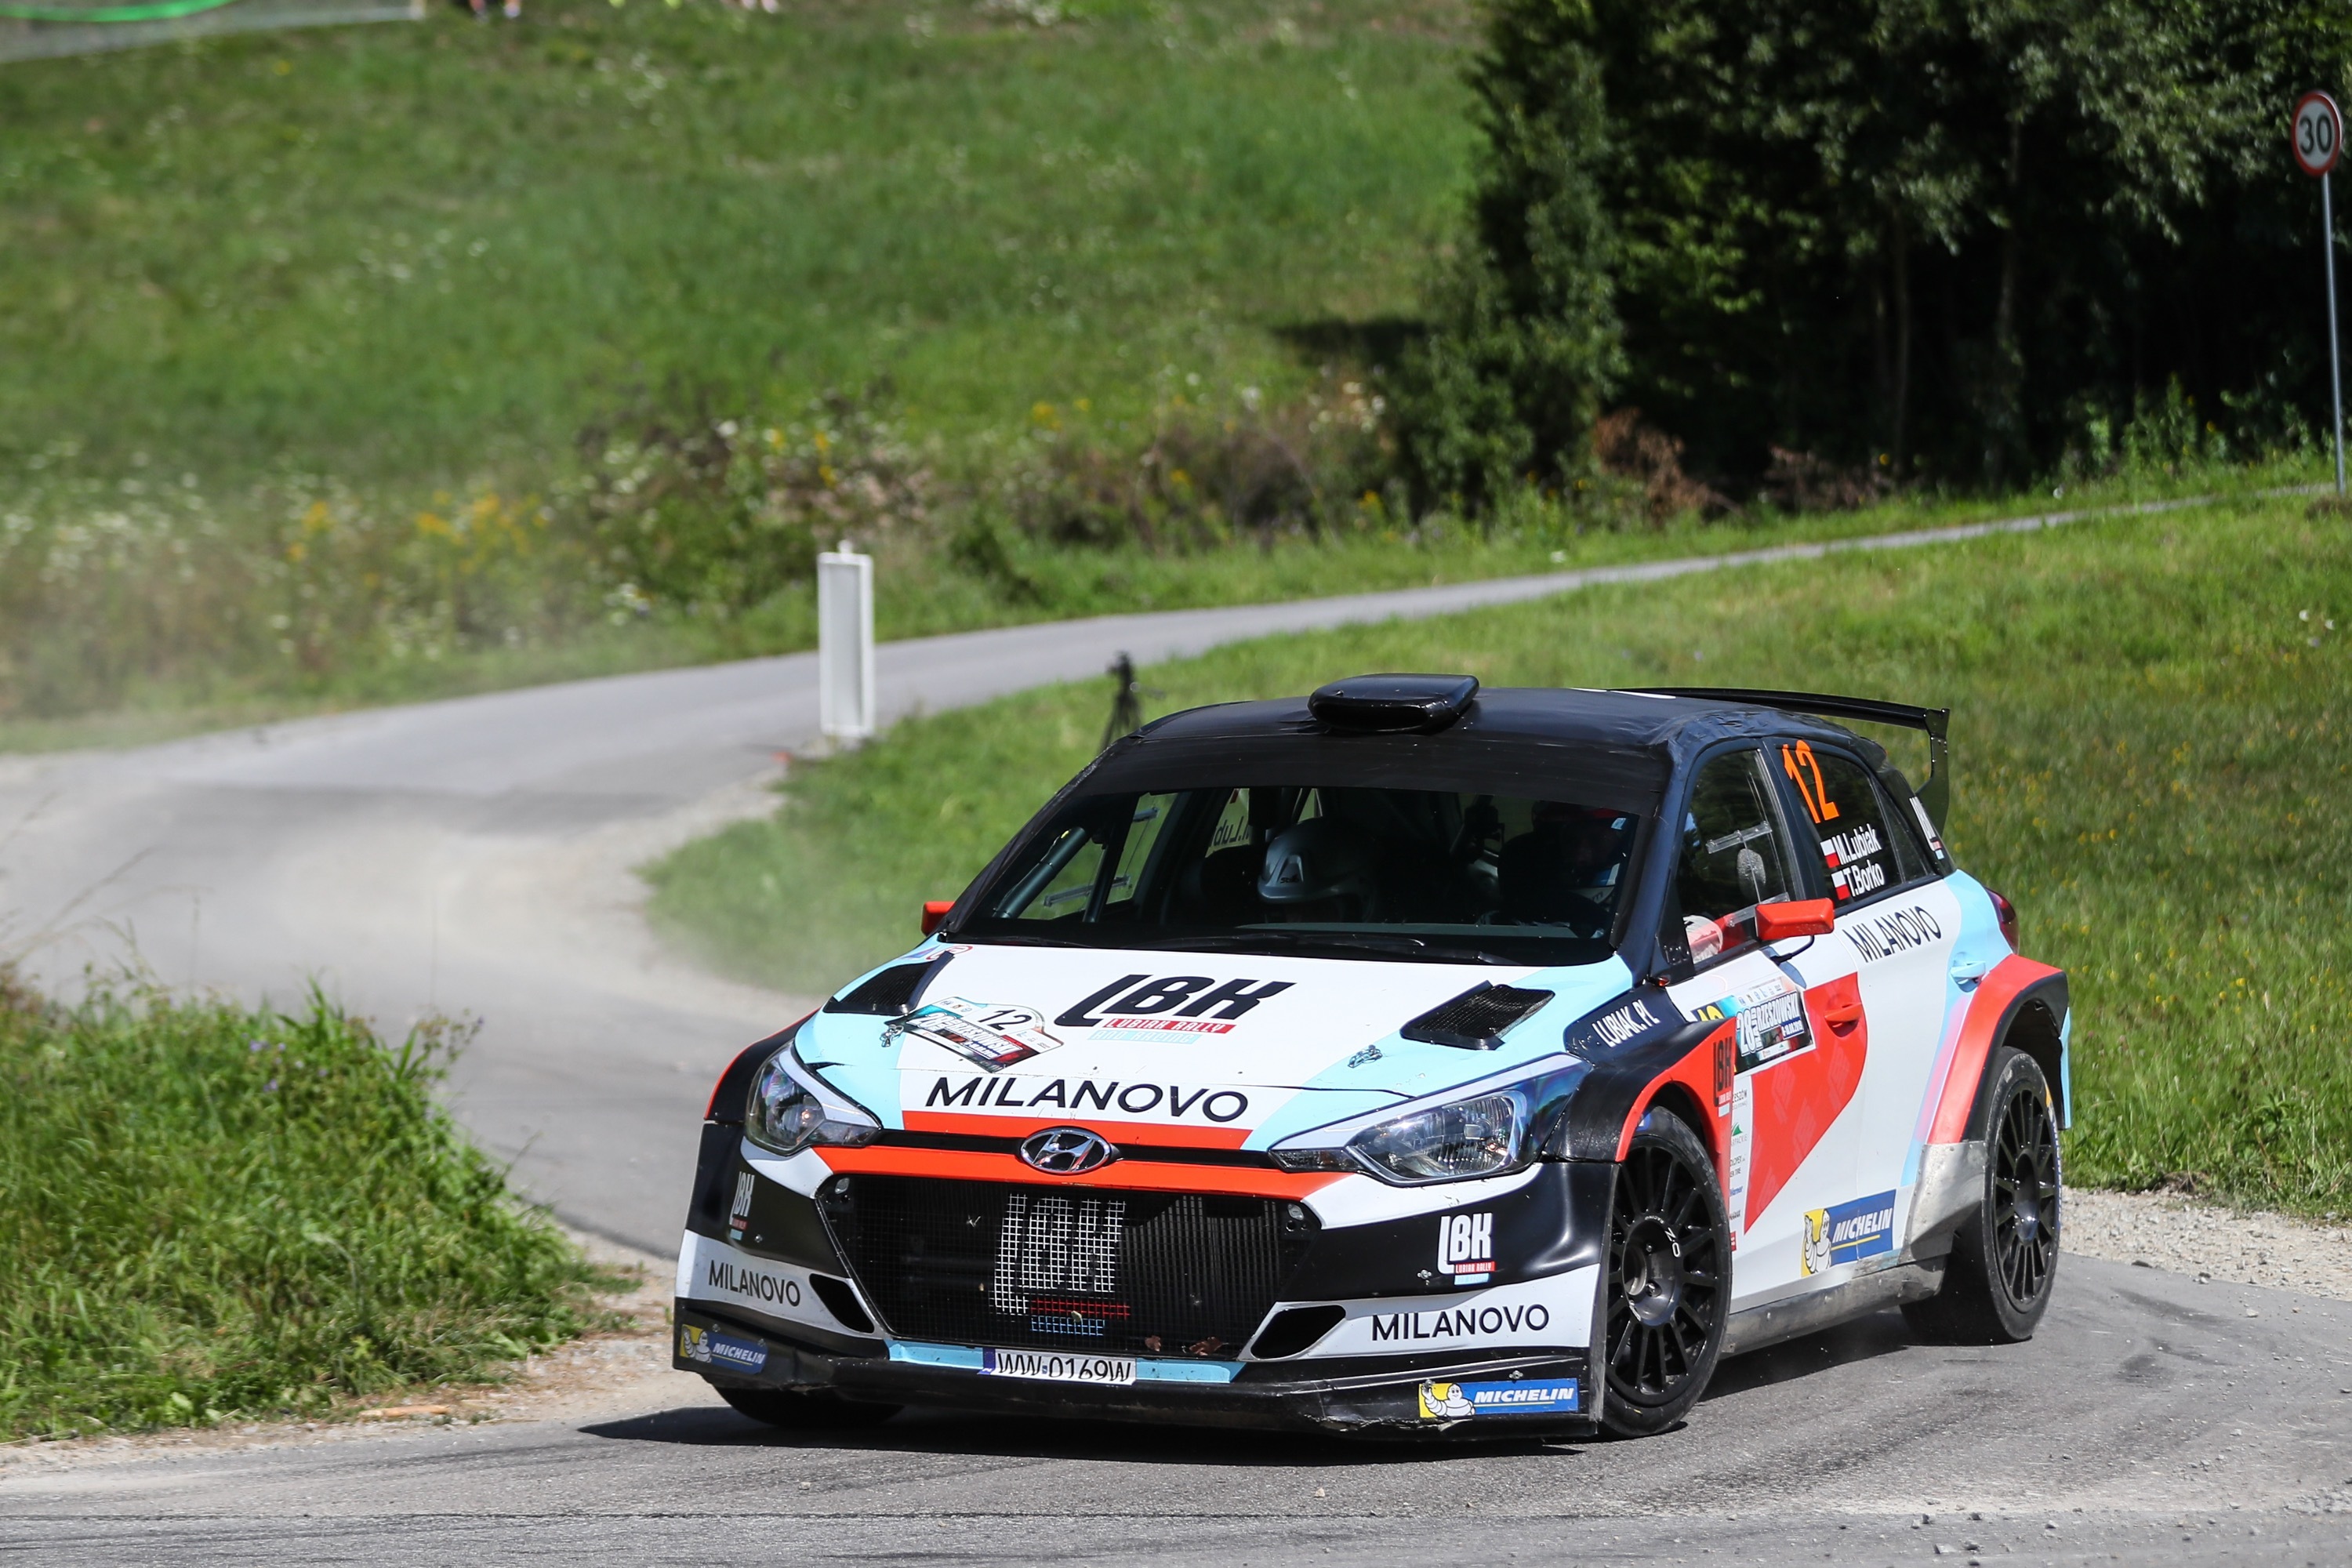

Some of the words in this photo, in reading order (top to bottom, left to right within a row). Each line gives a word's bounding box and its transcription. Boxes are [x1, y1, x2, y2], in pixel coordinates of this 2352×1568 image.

[2299, 115, 2332, 156] 30
[1782, 739, 1839, 824] 12
[1832, 823, 1882, 865] M.Lubiak
[1843, 859, 1886, 897] T.Borko
[1842, 906, 1941, 963] MILANOVO
[978, 1009, 1033, 1031] 12
[1054, 974, 1298, 1027] LBK
[1094, 1030, 1127, 1040] AND
[1132, 1032, 1196, 1044] RACING
[1106, 1018, 1169, 1030] LUBIAK
[1171, 1021, 1226, 1033] RALLY
[1592, 999, 1661, 1047] LUBIAK.PL
[925, 1076, 1248, 1123] MILANOVO
[1438, 1213, 1493, 1275] LBK
[1832, 1207, 1893, 1244] MICHELIN
[709, 1260, 800, 1307] MILANOVO
[1372, 1304, 1549, 1341] MILANOVO
[712, 1342, 766, 1364] MICHELIN
[997, 1353, 1042, 1376] WW
[1048, 1356, 1131, 1382] 0169W
[1475, 1387, 1574, 1403] MICHELIN
